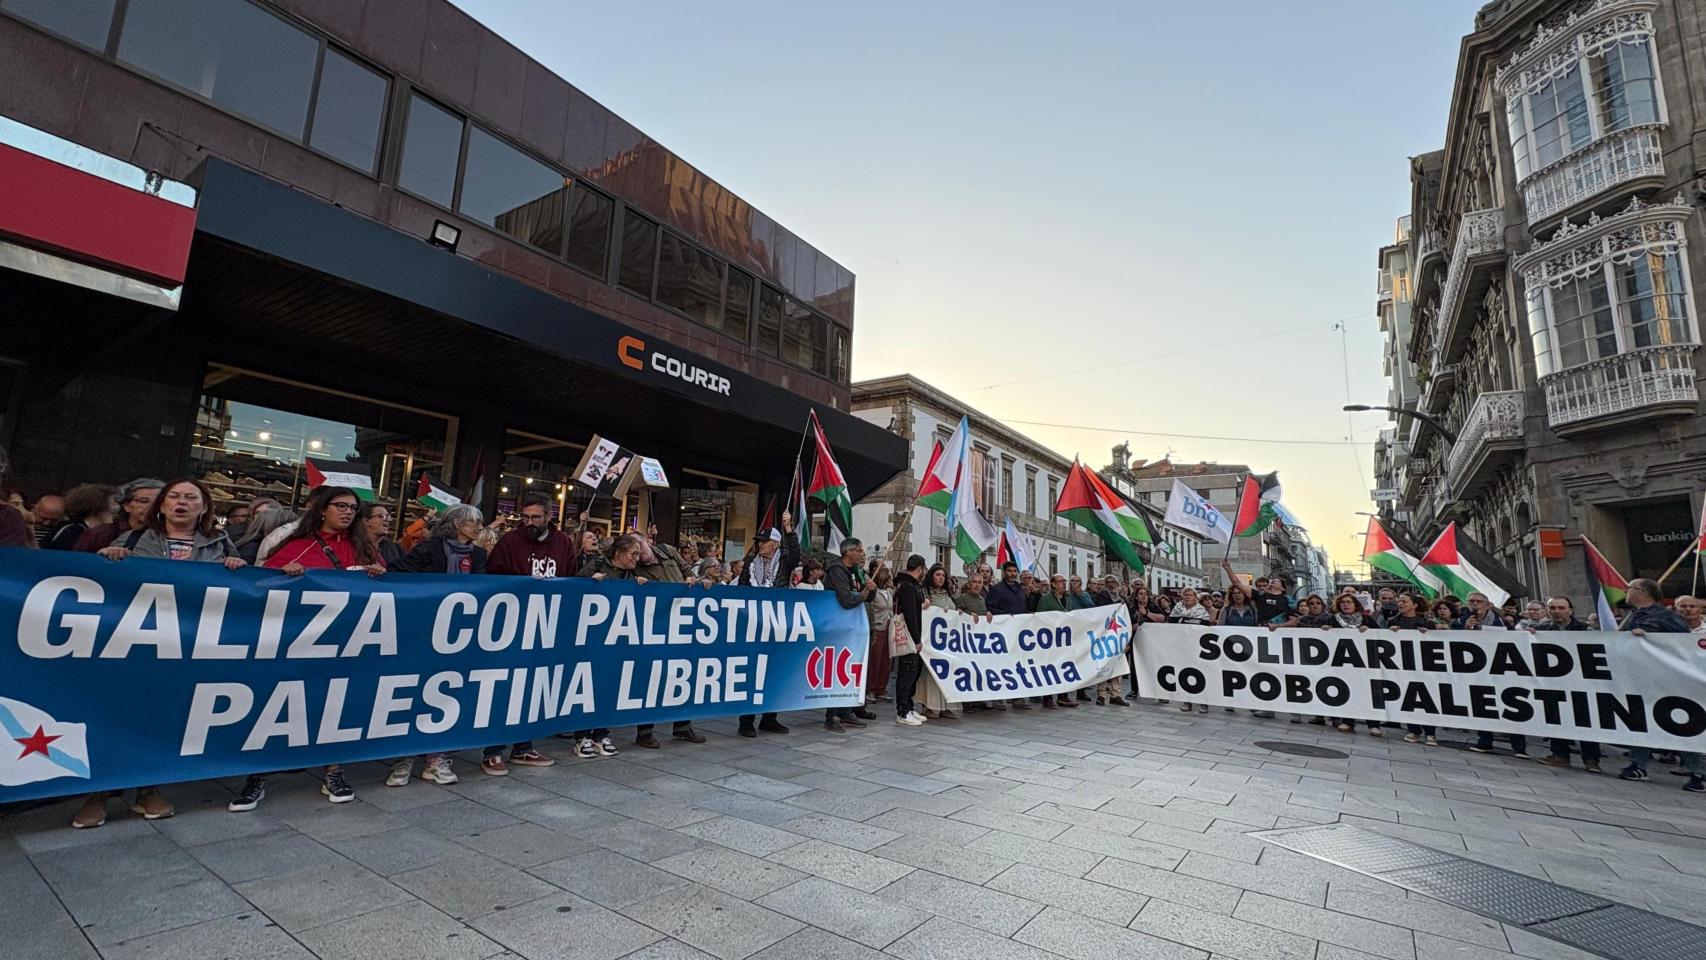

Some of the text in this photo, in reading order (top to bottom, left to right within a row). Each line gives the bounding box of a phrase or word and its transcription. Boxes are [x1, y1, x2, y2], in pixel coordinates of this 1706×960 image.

[651, 352, 731, 396] COURIR
[1183, 496, 1219, 528] bng
[17, 576, 816, 660] GALIZA CON PALESTINA
[930, 617, 1008, 654] Galiza
[1018, 625, 1072, 653] con
[930, 656, 1081, 692] Palestina
[1199, 633, 1612, 681] SOLIDARIEDADE
[180, 654, 769, 757] PALESTINA LIBRE!
[1157, 665, 1706, 738] CO POBO PALESTINO
